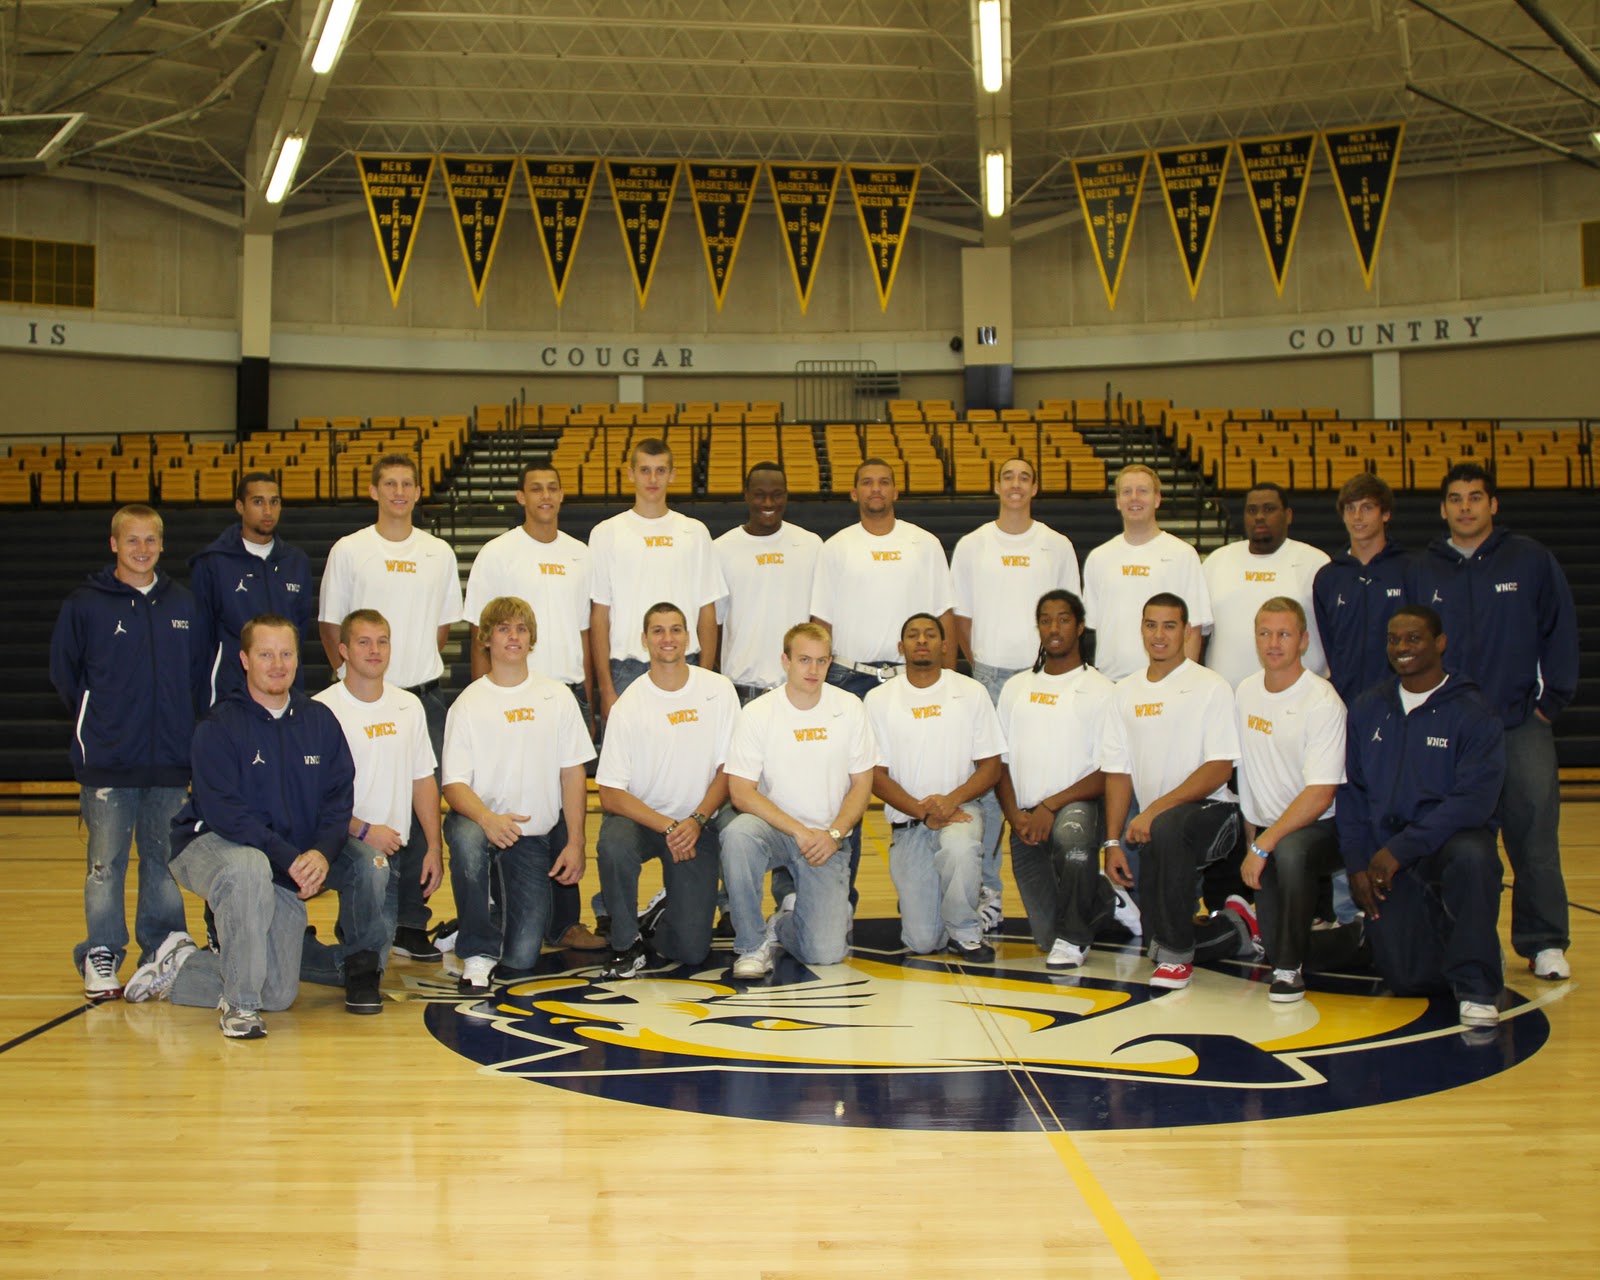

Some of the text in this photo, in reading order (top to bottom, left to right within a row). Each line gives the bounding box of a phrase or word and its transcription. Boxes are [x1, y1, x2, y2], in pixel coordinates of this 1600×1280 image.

[1247, 154, 1305, 168] BASKETBALL
[1164, 164, 1220, 178] BASKETBALL
[1251, 169, 1287, 181] REGION
[366, 173, 424, 184] BASKETBALL
[450, 174, 507, 185] BASKETBALL
[532, 175, 589, 186] BASKETBALL
[615, 178, 671, 189] BASKETBALL
[1082, 173, 1137, 187] BASKETBALL
[1167, 178, 1203, 190] REGION
[370, 186, 406, 197] REGION
[695, 180, 750, 191] BASKETBALL
[777, 181, 831, 192] BASKETBALL
[856, 183, 911, 194] BASKETBALL
[454, 187, 488, 198] REGION
[534, 188, 569, 199] REGION
[618, 190, 652, 201] REGION
[697, 192, 731, 203] REGION
[781, 193, 812, 204] REGION
[1085, 188, 1120, 199] REGION
[859, 196, 893, 207] REGION
[28, 323, 66, 345] IS
[1289, 316, 1482, 349] COUNTRY
[541, 347, 693, 367] COUGAR
[643, 536, 673, 547] WNCC
[755, 553, 784, 565] WNCC
[871, 551, 901, 561] WNCC
[1001, 555, 1030, 567] WNCC
[385, 560, 416, 573] WNCC
[538, 563, 565, 575] WNCC
[1122, 565, 1150, 577] WNCC
[1245, 571, 1276, 582] WNCC
[1030, 692, 1059, 705] WNCC
[504, 708, 535, 722] WNCC
[911, 705, 942, 719] WNCC
[1135, 702, 1164, 717] WNCC
[667, 709, 698, 725] WNCC
[363, 722, 397, 739] WNCC
[1248, 714, 1272, 735] WNCC
[793, 728, 827, 742] WNCC
